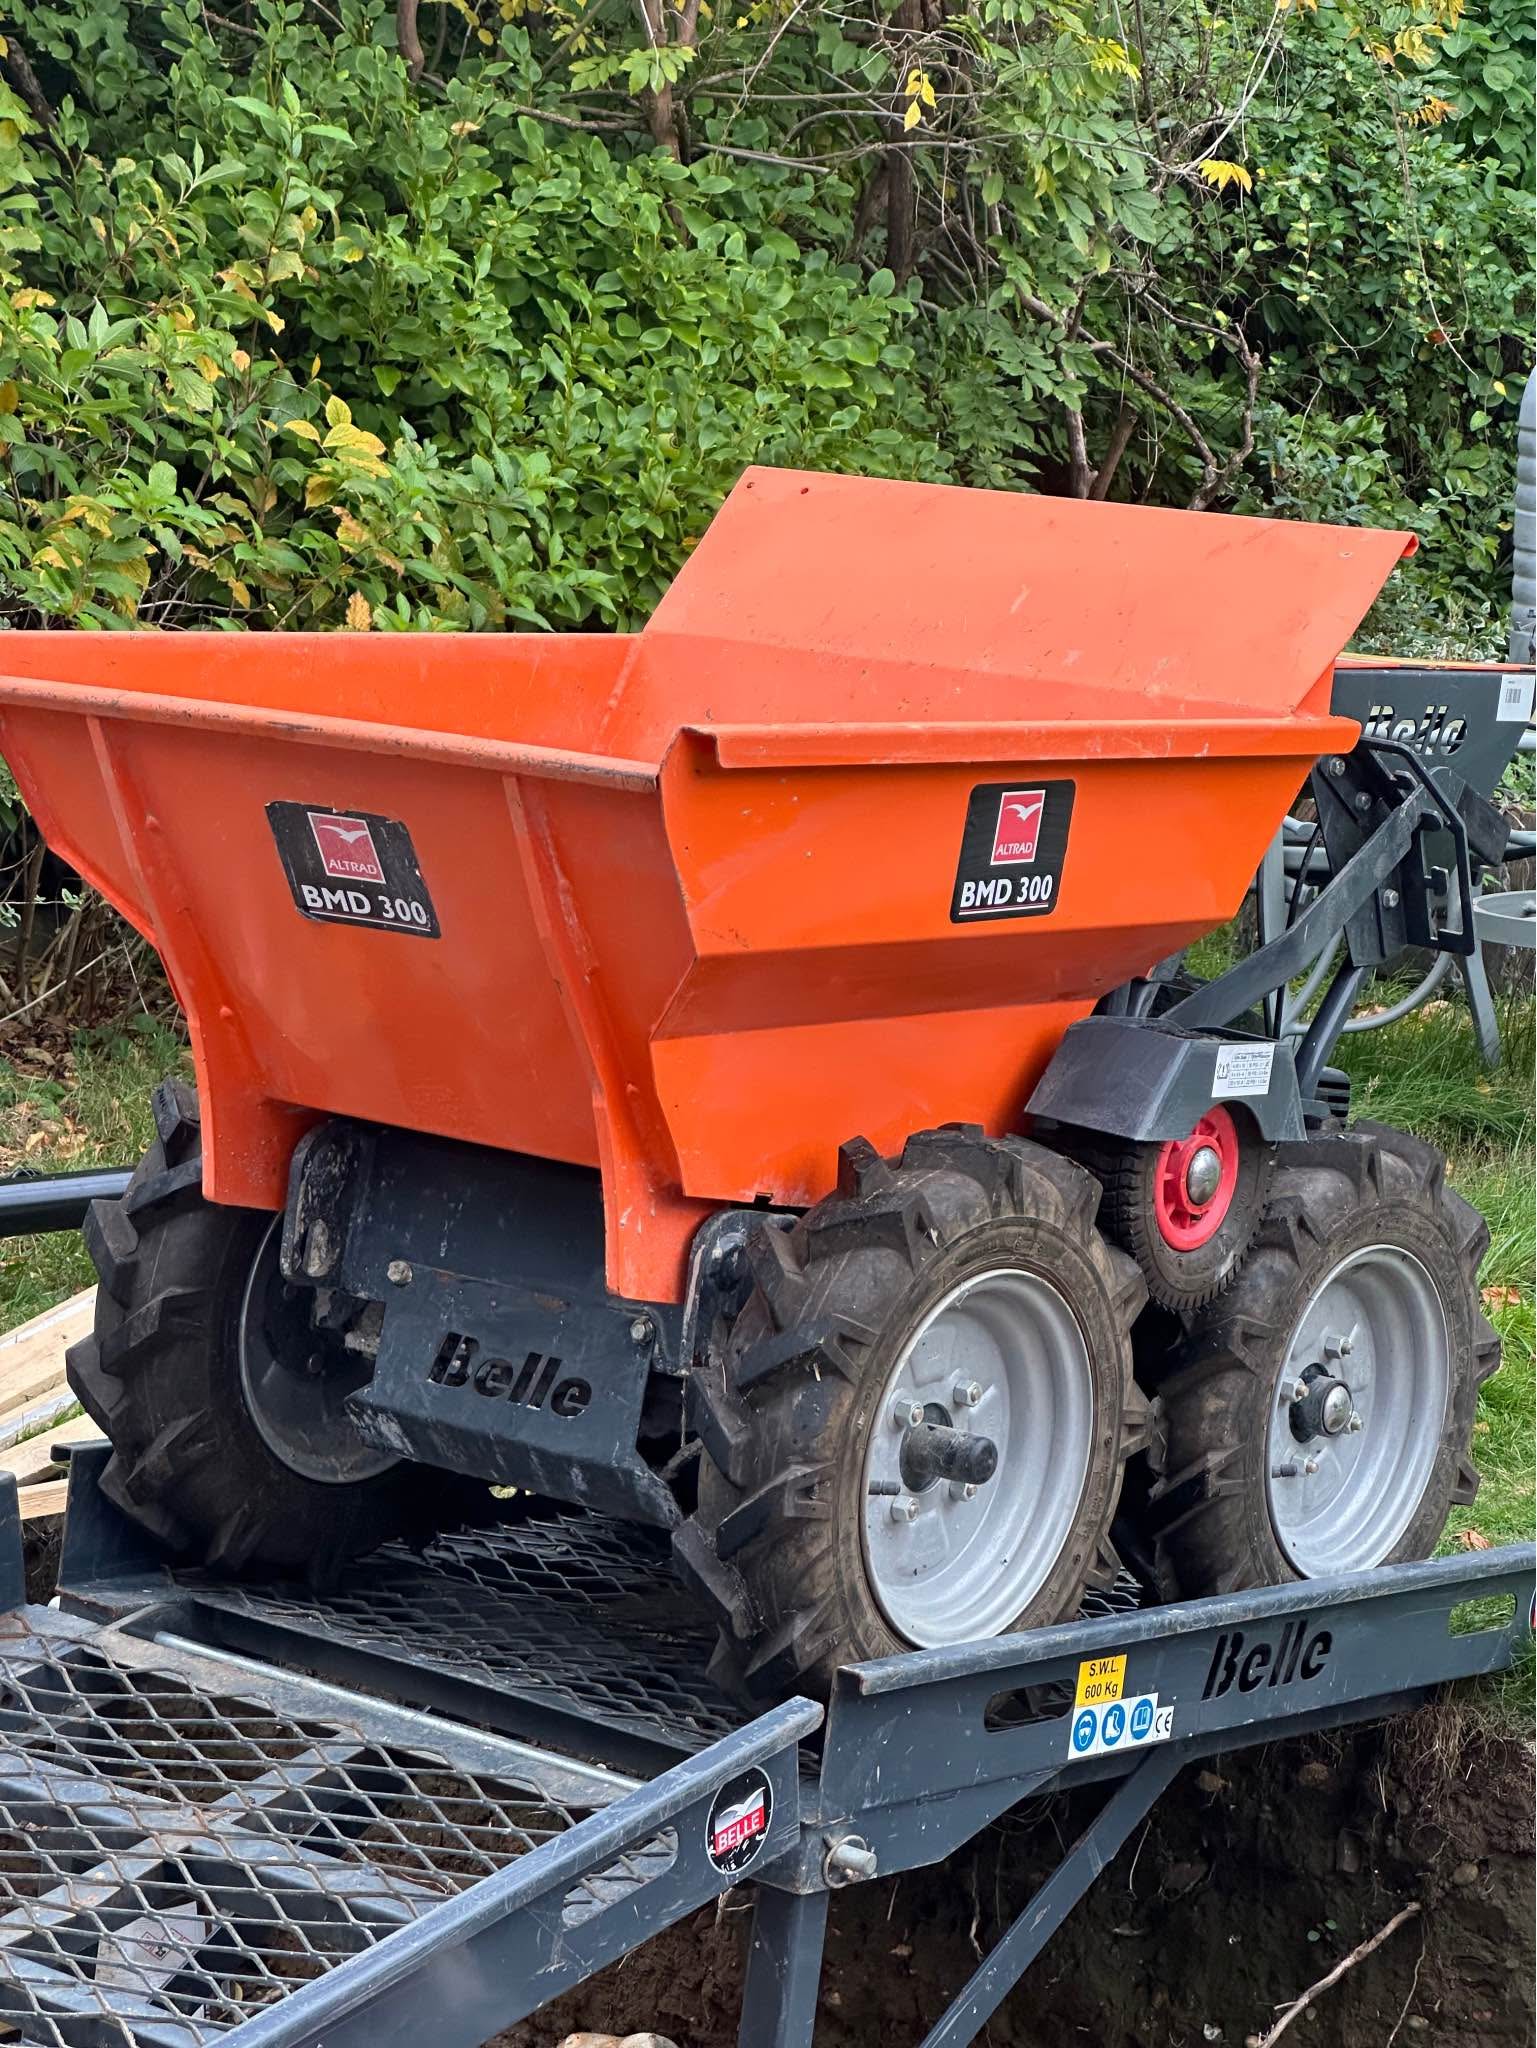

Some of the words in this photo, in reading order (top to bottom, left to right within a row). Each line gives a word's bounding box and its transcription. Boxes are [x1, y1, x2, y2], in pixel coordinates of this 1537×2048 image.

[1363, 704, 1468, 756] Belle
[329, 859, 377, 875] ALTRAD
[996, 842, 1033, 856] ALTRAD
[301, 884, 372, 915] BMD
[378, 895, 427, 925] 300
[960, 878, 1013, 908] BMD
[1016, 874, 1053, 903] 300
[426, 1331, 593, 1419] Belle
[1089, 1660, 1119, 1677] S.W.L.
[1201, 1618, 1334, 1701] Belle
[1085, 1683, 1102, 1699] 600
[1104, 1681, 1119, 1697] Kg
[718, 1812, 761, 1853] BELLE
